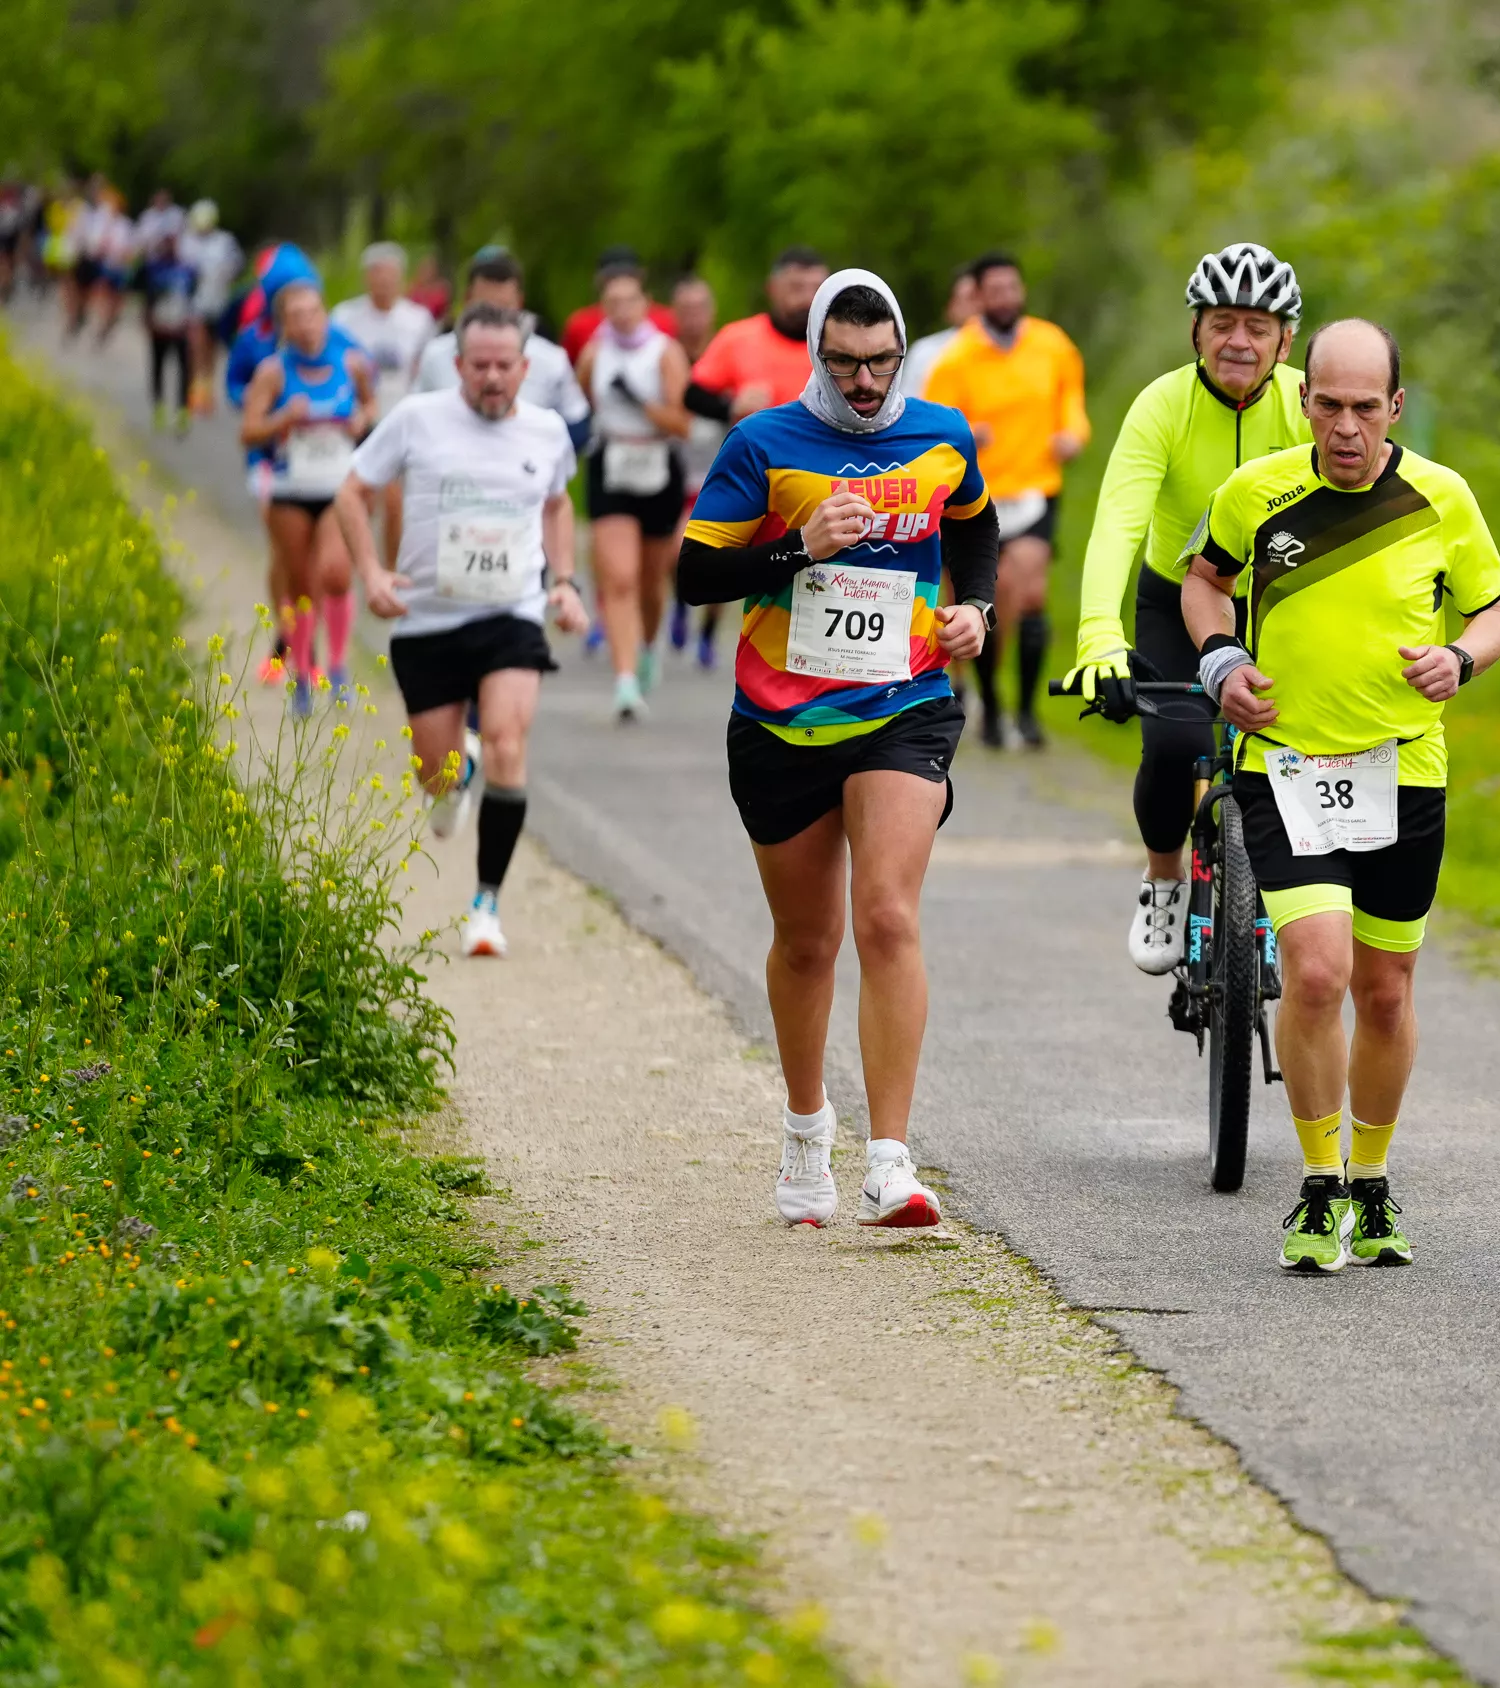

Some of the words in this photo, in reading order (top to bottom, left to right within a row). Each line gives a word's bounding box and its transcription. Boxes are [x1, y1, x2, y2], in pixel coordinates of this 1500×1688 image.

[831, 479, 917, 508] EVER
[846, 513, 890, 538] VE
[893, 513, 930, 540] UP
[464, 550, 508, 573] 784
[843, 586, 881, 601] LUCENA
[825, 608, 884, 642] 709
[1318, 758, 1358, 769] LUCENA
[1315, 779, 1354, 809] 38
